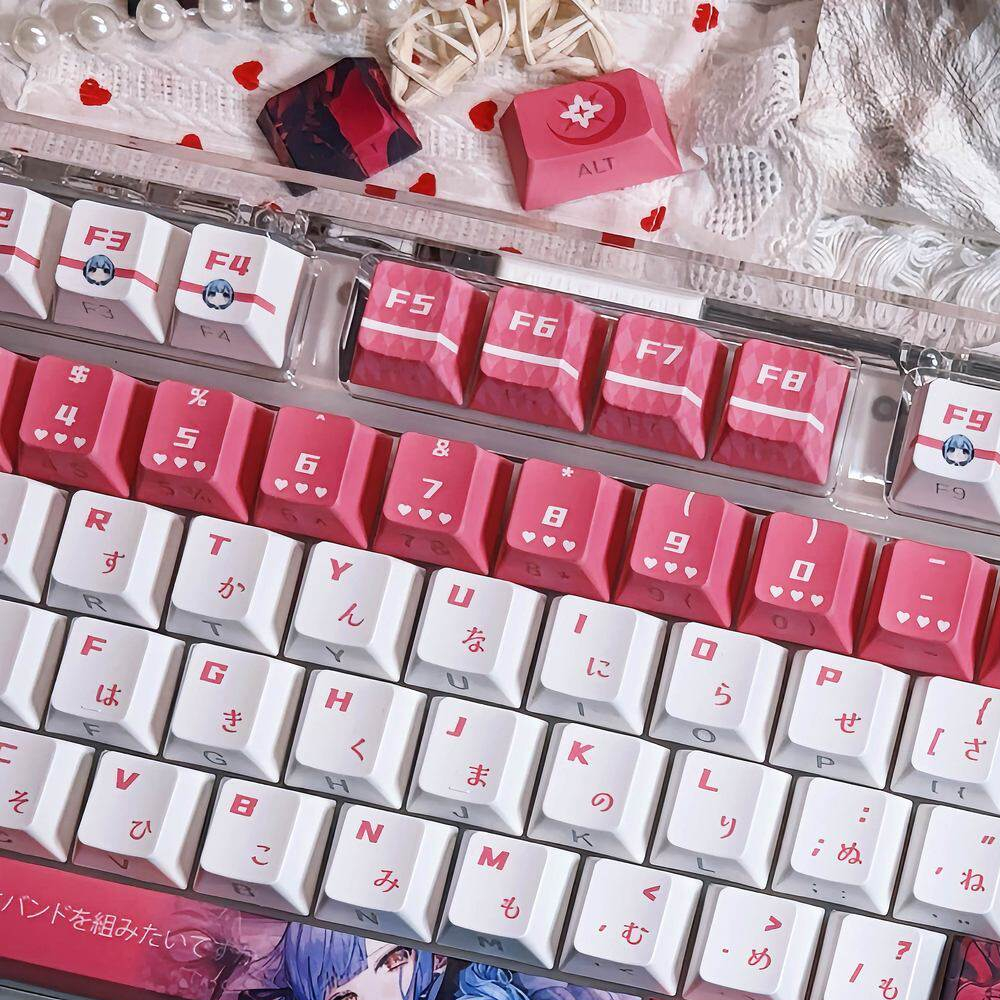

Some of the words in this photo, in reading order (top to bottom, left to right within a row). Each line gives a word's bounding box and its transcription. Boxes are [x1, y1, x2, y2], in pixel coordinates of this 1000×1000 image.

[578, 156, 615, 178] ALT
[84, 226, 131, 251] F3
[205, 250, 251, 276] F4
[386, 288, 434, 315] F5
[509, 311, 558, 337] F6
[637, 339, 683, 364] F7
[69, 365, 90, 383] $
[757, 364, 806, 391] F8
[188, 388, 208, 406] %
[56, 404, 75, 425] 4
[943, 404, 992, 432] F9
[174, 427, 199, 448] 5
[432, 439, 449, 456] &
[295, 453, 320, 474] 6
[423, 478, 442, 498] 7
[936, 483, 965, 500] F9
[684, 492, 695, 516] (
[85, 508, 112, 531] R
[542, 506, 567, 527] 8
[664, 532, 690, 553] 9
[807, 519, 819, 544] )
[210, 534, 231, 555] T
[102, 551, 125, 573] す
[330, 558, 353, 581] Y
[789, 560, 815, 581] 0
[218, 577, 245, 599] か
[448, 584, 475, 608] U
[338, 603, 364, 626] ん
[574, 614, 587, 634] I
[81, 635, 107, 655] F
[462, 627, 485, 652] な
[691, 638, 718, 661] O
[200, 661, 228, 684] G
[587, 657, 610, 678] に
[816, 666, 842, 686] P
[96, 684, 121, 706] は
[325, 688, 353, 712] H
[715, 683, 731, 705] ら
[222, 710, 242, 733] き
[446, 717, 467, 737] J
[835, 713, 861, 733] せ
[351, 738, 365, 761] く
[568, 741, 594, 765] K
[964, 739, 986, 761] さ
[116, 768, 140, 790] V
[468, 764, 489, 787] ま
[698, 768, 718, 792] L
[9, 790, 29, 814] そ
[230, 794, 258, 817] B
[592, 793, 614, 812] の
[130, 821, 151, 840] ひ
[356, 820, 384, 843] N
[720, 816, 736, 839] り
[252, 845, 270, 865] こ
[478, 846, 509, 870] M
[838, 843, 862, 864] ぬ
[374, 870, 399, 892] み
[960, 869, 985, 891] ね
[501, 897, 519, 919] も
[622, 922, 649, 945] む
[748, 948, 771, 970] め
[896, 941, 912, 960] ?
[879, 978, 898, 1000] も
